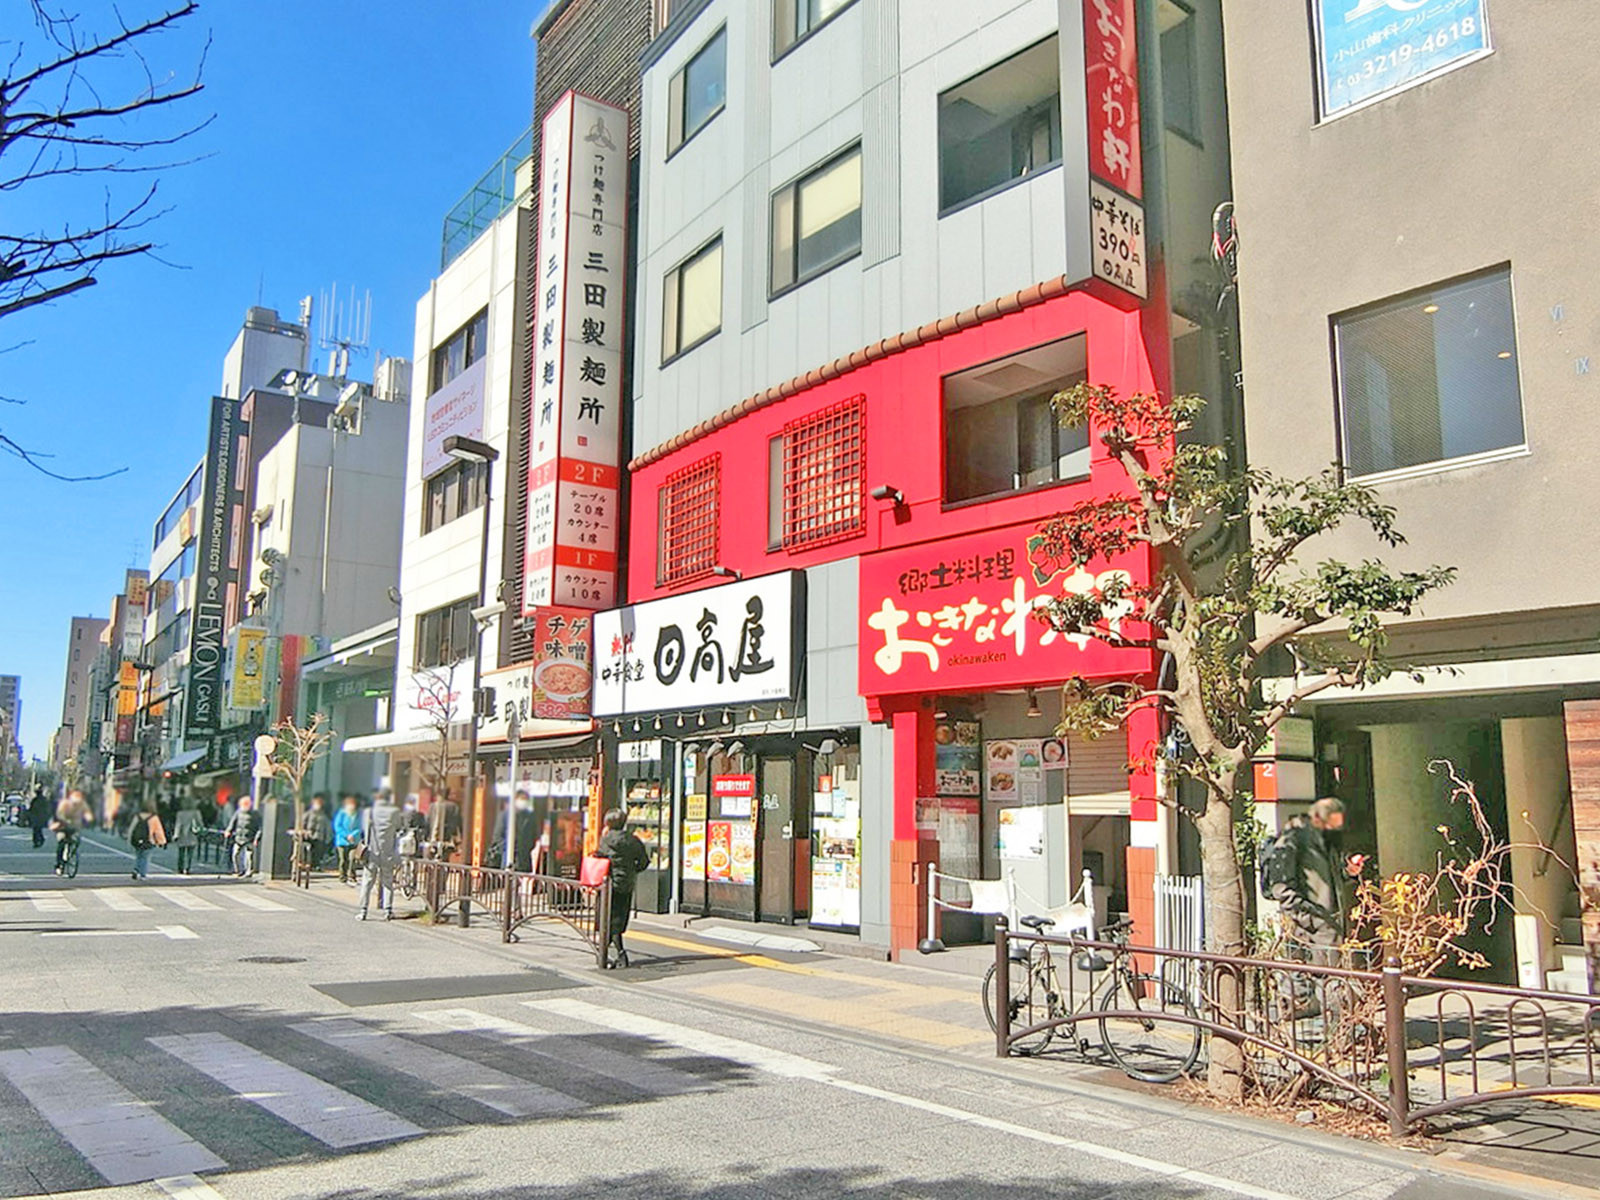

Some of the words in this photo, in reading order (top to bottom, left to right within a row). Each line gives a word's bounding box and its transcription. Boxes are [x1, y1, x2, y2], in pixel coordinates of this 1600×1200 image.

[1363, 17, 1475, 78] 3219-4618
[577, 251, 609, 426] 三田製麺所
[575, 463, 605, 483] 2F
[570, 489, 607, 503] テーブル
[574, 503, 604, 517] 20席
[567, 517, 609, 530] カウンター
[578, 532, 598, 544] 4席
[575, 551, 598, 566] 1F
[564, 574, 608, 586] カウンター
[898, 548, 1015, 596] 郷土料理
[571, 587, 601, 601] 10席
[548, 616, 588, 638] チゲ
[193, 603, 223, 682] LEMON
[653, 594, 775, 685] 日高屋
[545, 639, 587, 660] 味噌
[946, 651, 1007, 667] okinawaken
[1262, 764, 1274, 777] 2
